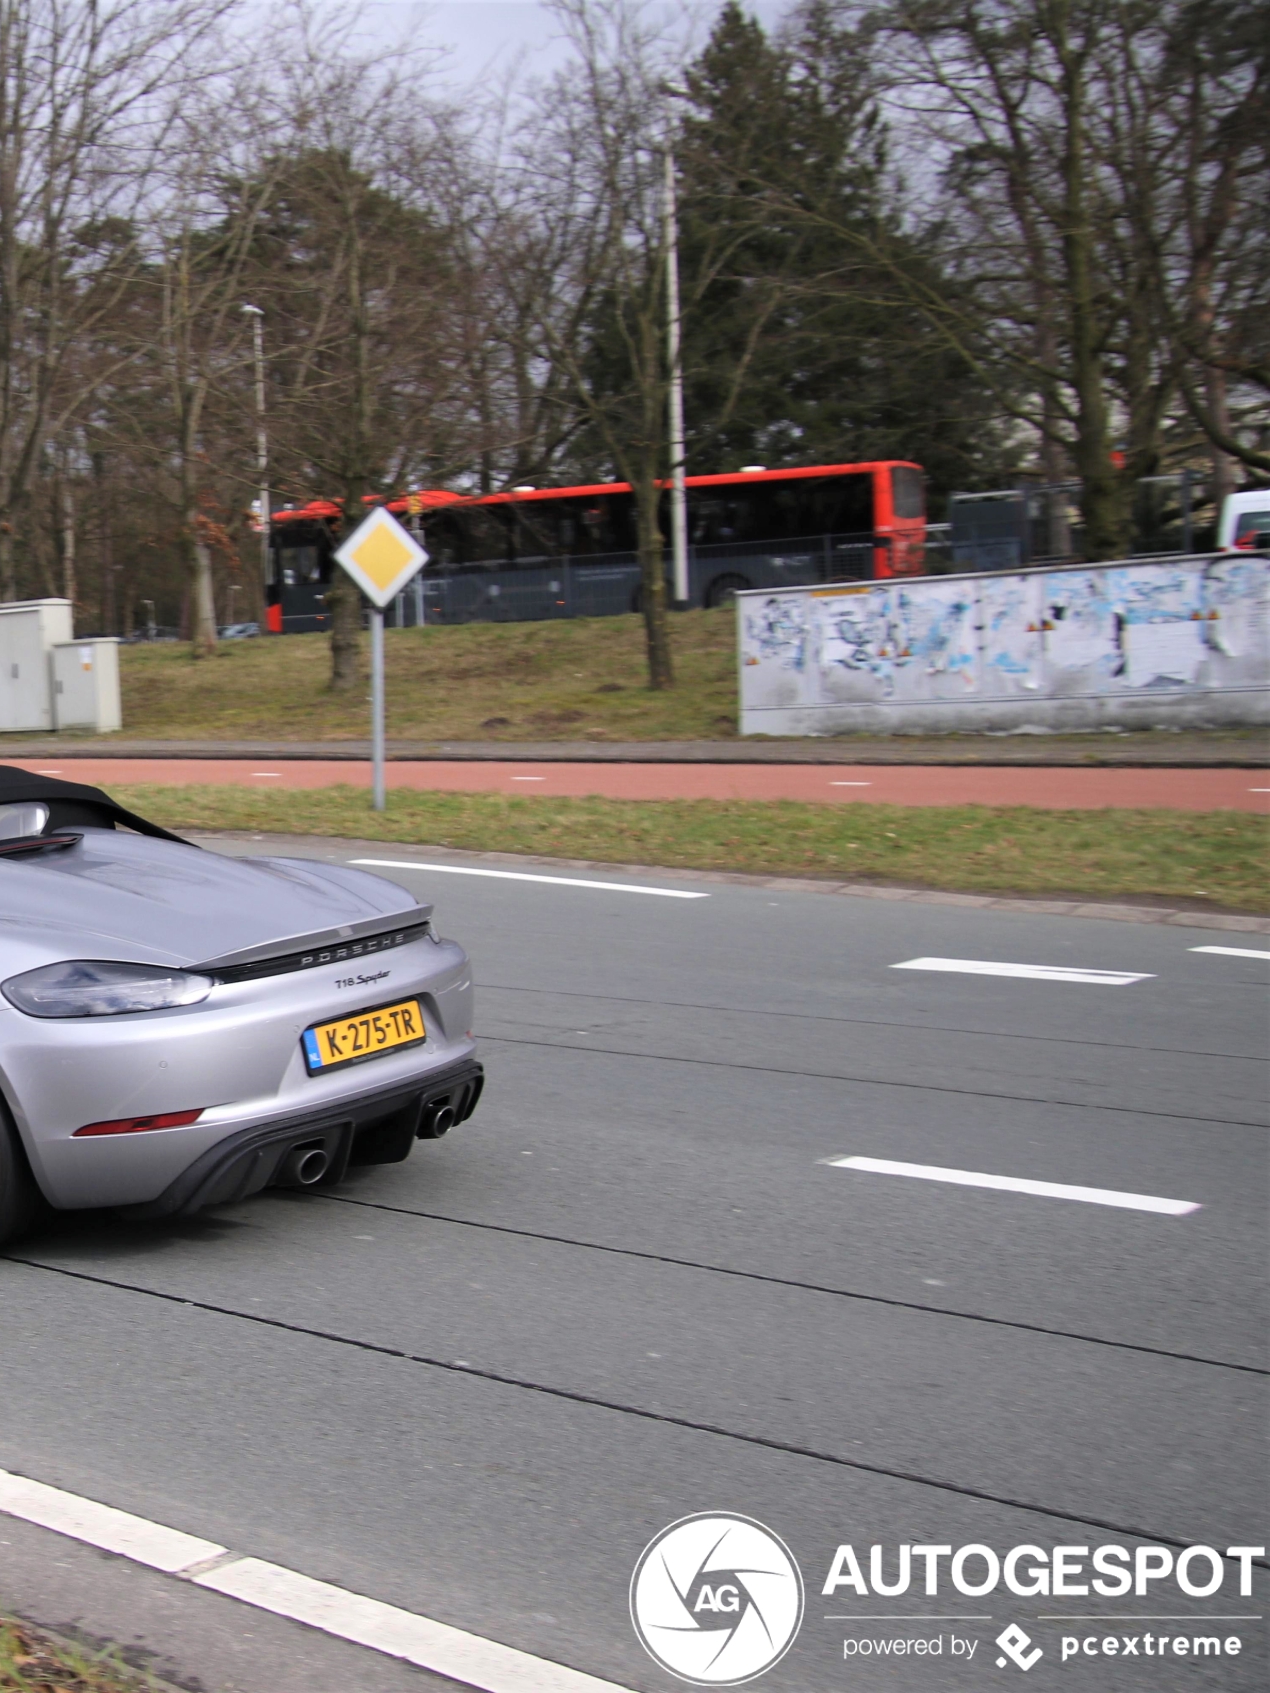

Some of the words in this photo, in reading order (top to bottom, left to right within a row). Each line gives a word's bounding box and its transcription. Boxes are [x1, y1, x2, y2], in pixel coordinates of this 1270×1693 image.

[301, 934, 404, 966] PORSCHE
[334, 977, 355, 989] 718
[355, 970, 391, 986] Spyder
[326, 1008, 416, 1057] K-275-TR
[308, 1052, 320, 1063] NL
